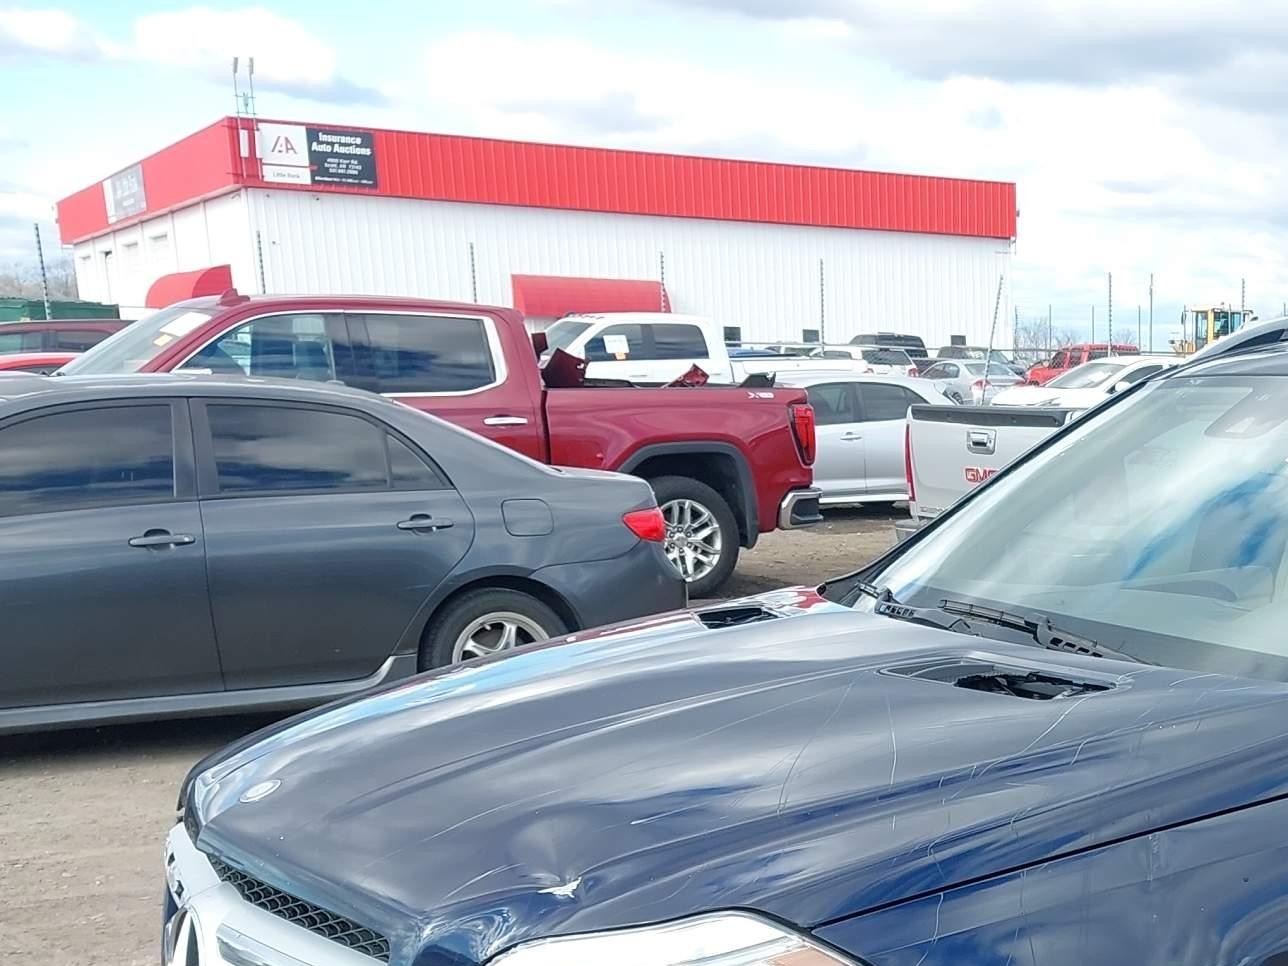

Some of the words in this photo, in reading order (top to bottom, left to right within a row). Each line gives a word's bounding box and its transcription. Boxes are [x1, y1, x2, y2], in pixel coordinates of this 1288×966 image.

[318, 132, 362, 145] Insurance
[311, 142, 332, 152] Auto
[333, 143, 372, 156] Auctions
